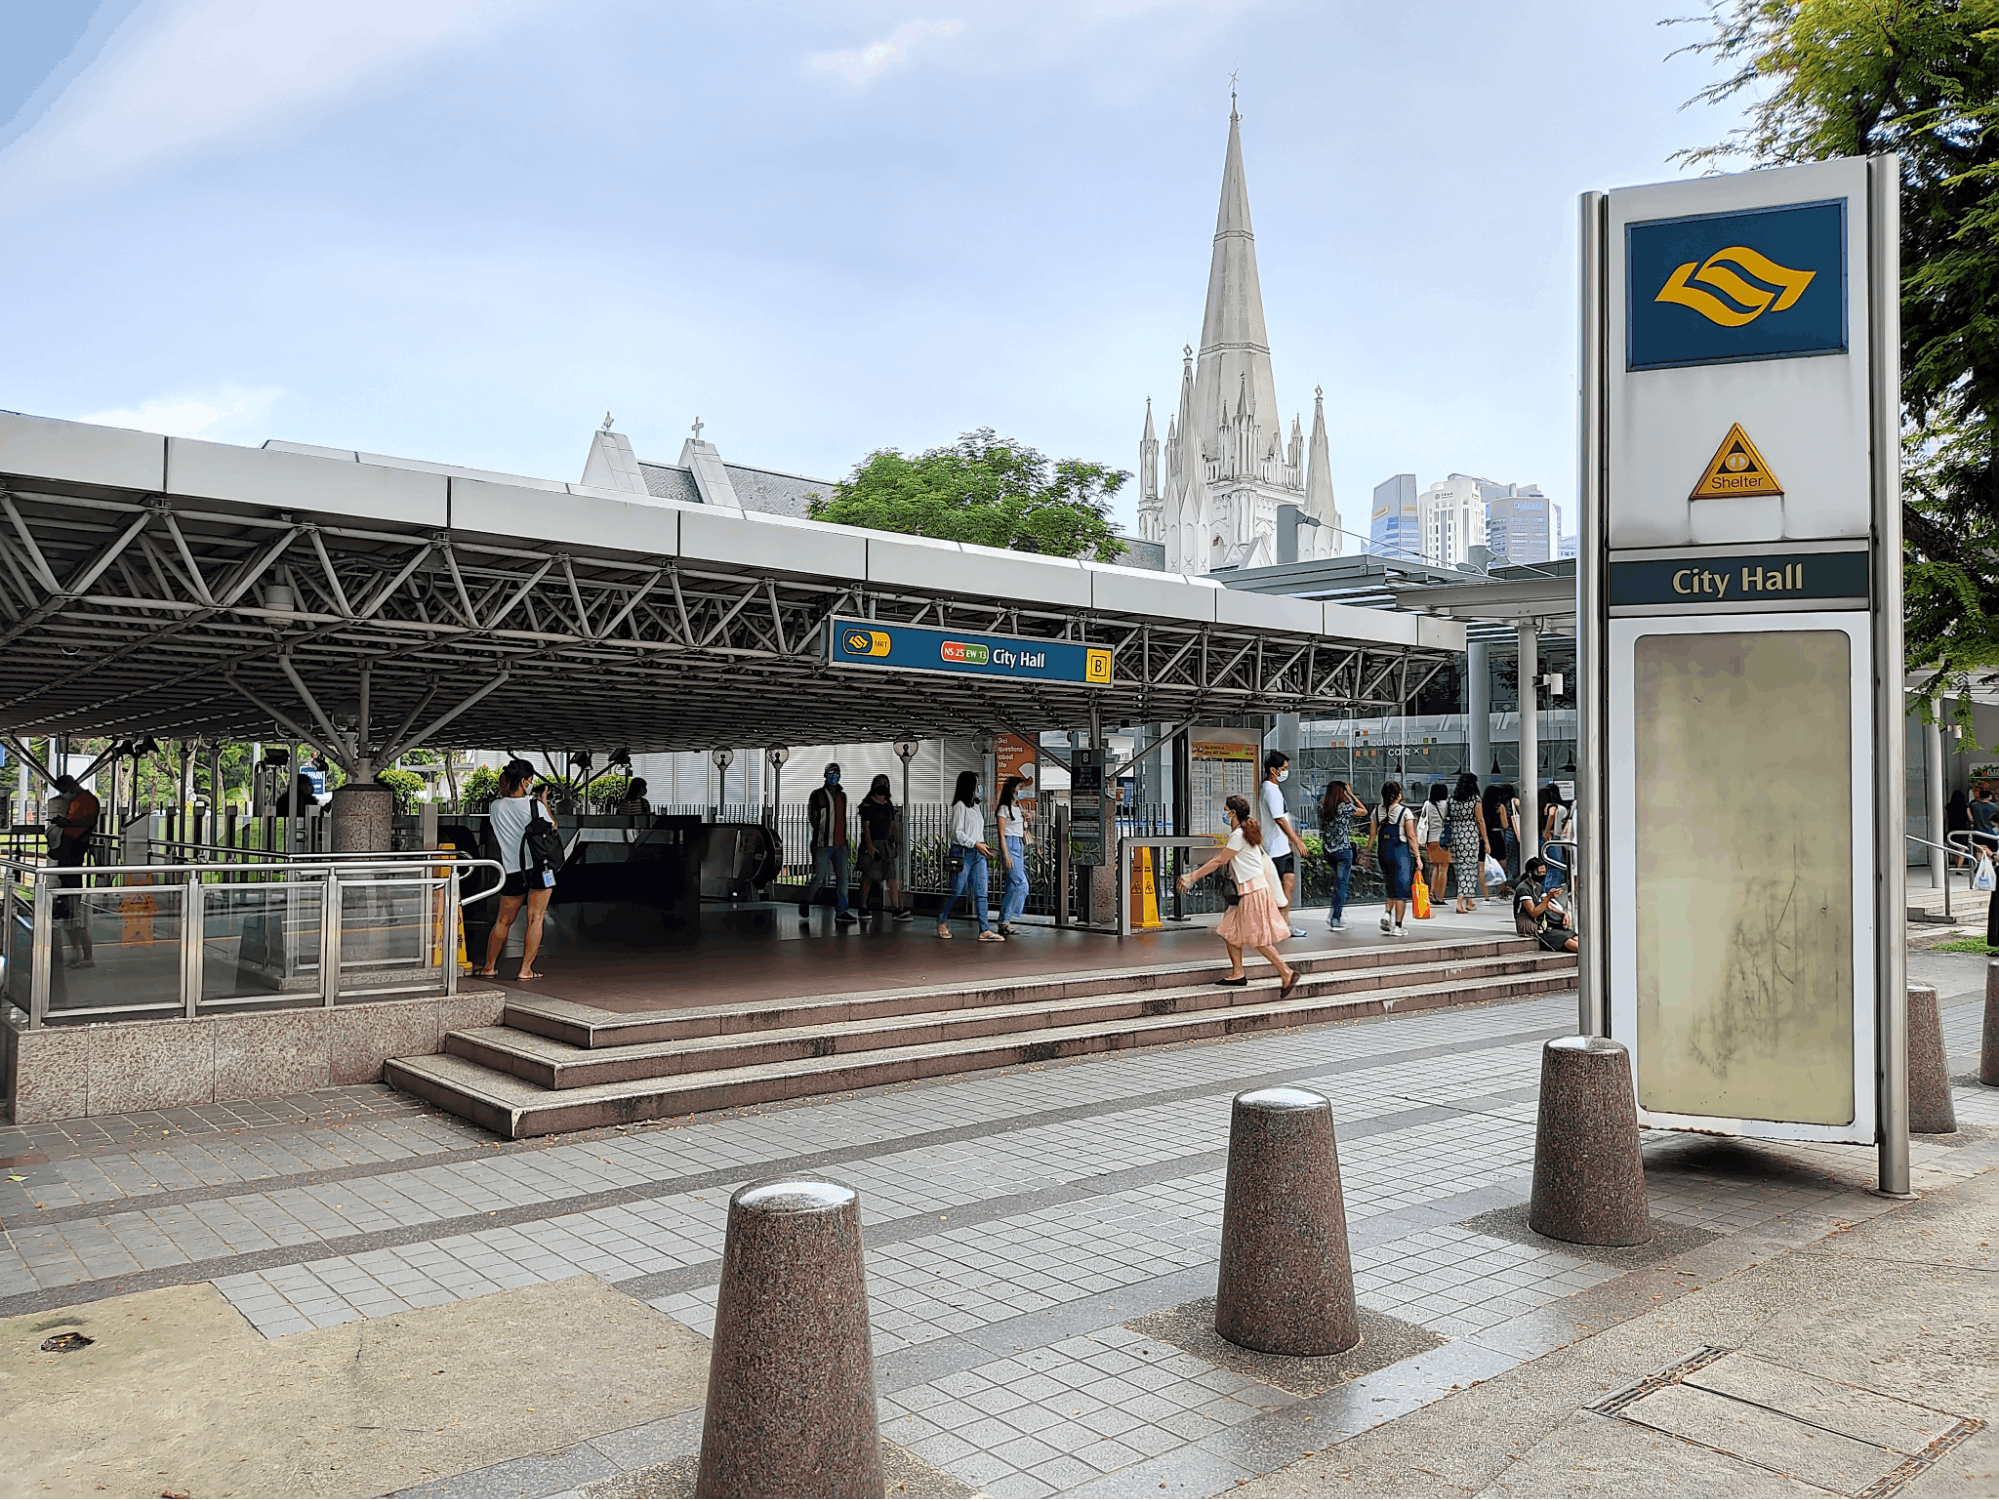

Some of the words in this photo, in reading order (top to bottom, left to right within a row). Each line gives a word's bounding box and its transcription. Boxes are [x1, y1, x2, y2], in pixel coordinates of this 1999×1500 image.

[1711, 475, 1764, 490] Shelter
[1672, 568, 1731, 598] City
[1741, 562, 1804, 592] Hall
[874, 639, 889, 649] MRT
[993, 648, 1017, 669] City
[1020, 651, 1046, 669] Hall
[1095, 660, 1102, 673] B
[1083, 752, 1089, 763] B
[1387, 747, 1411, 756] cae
